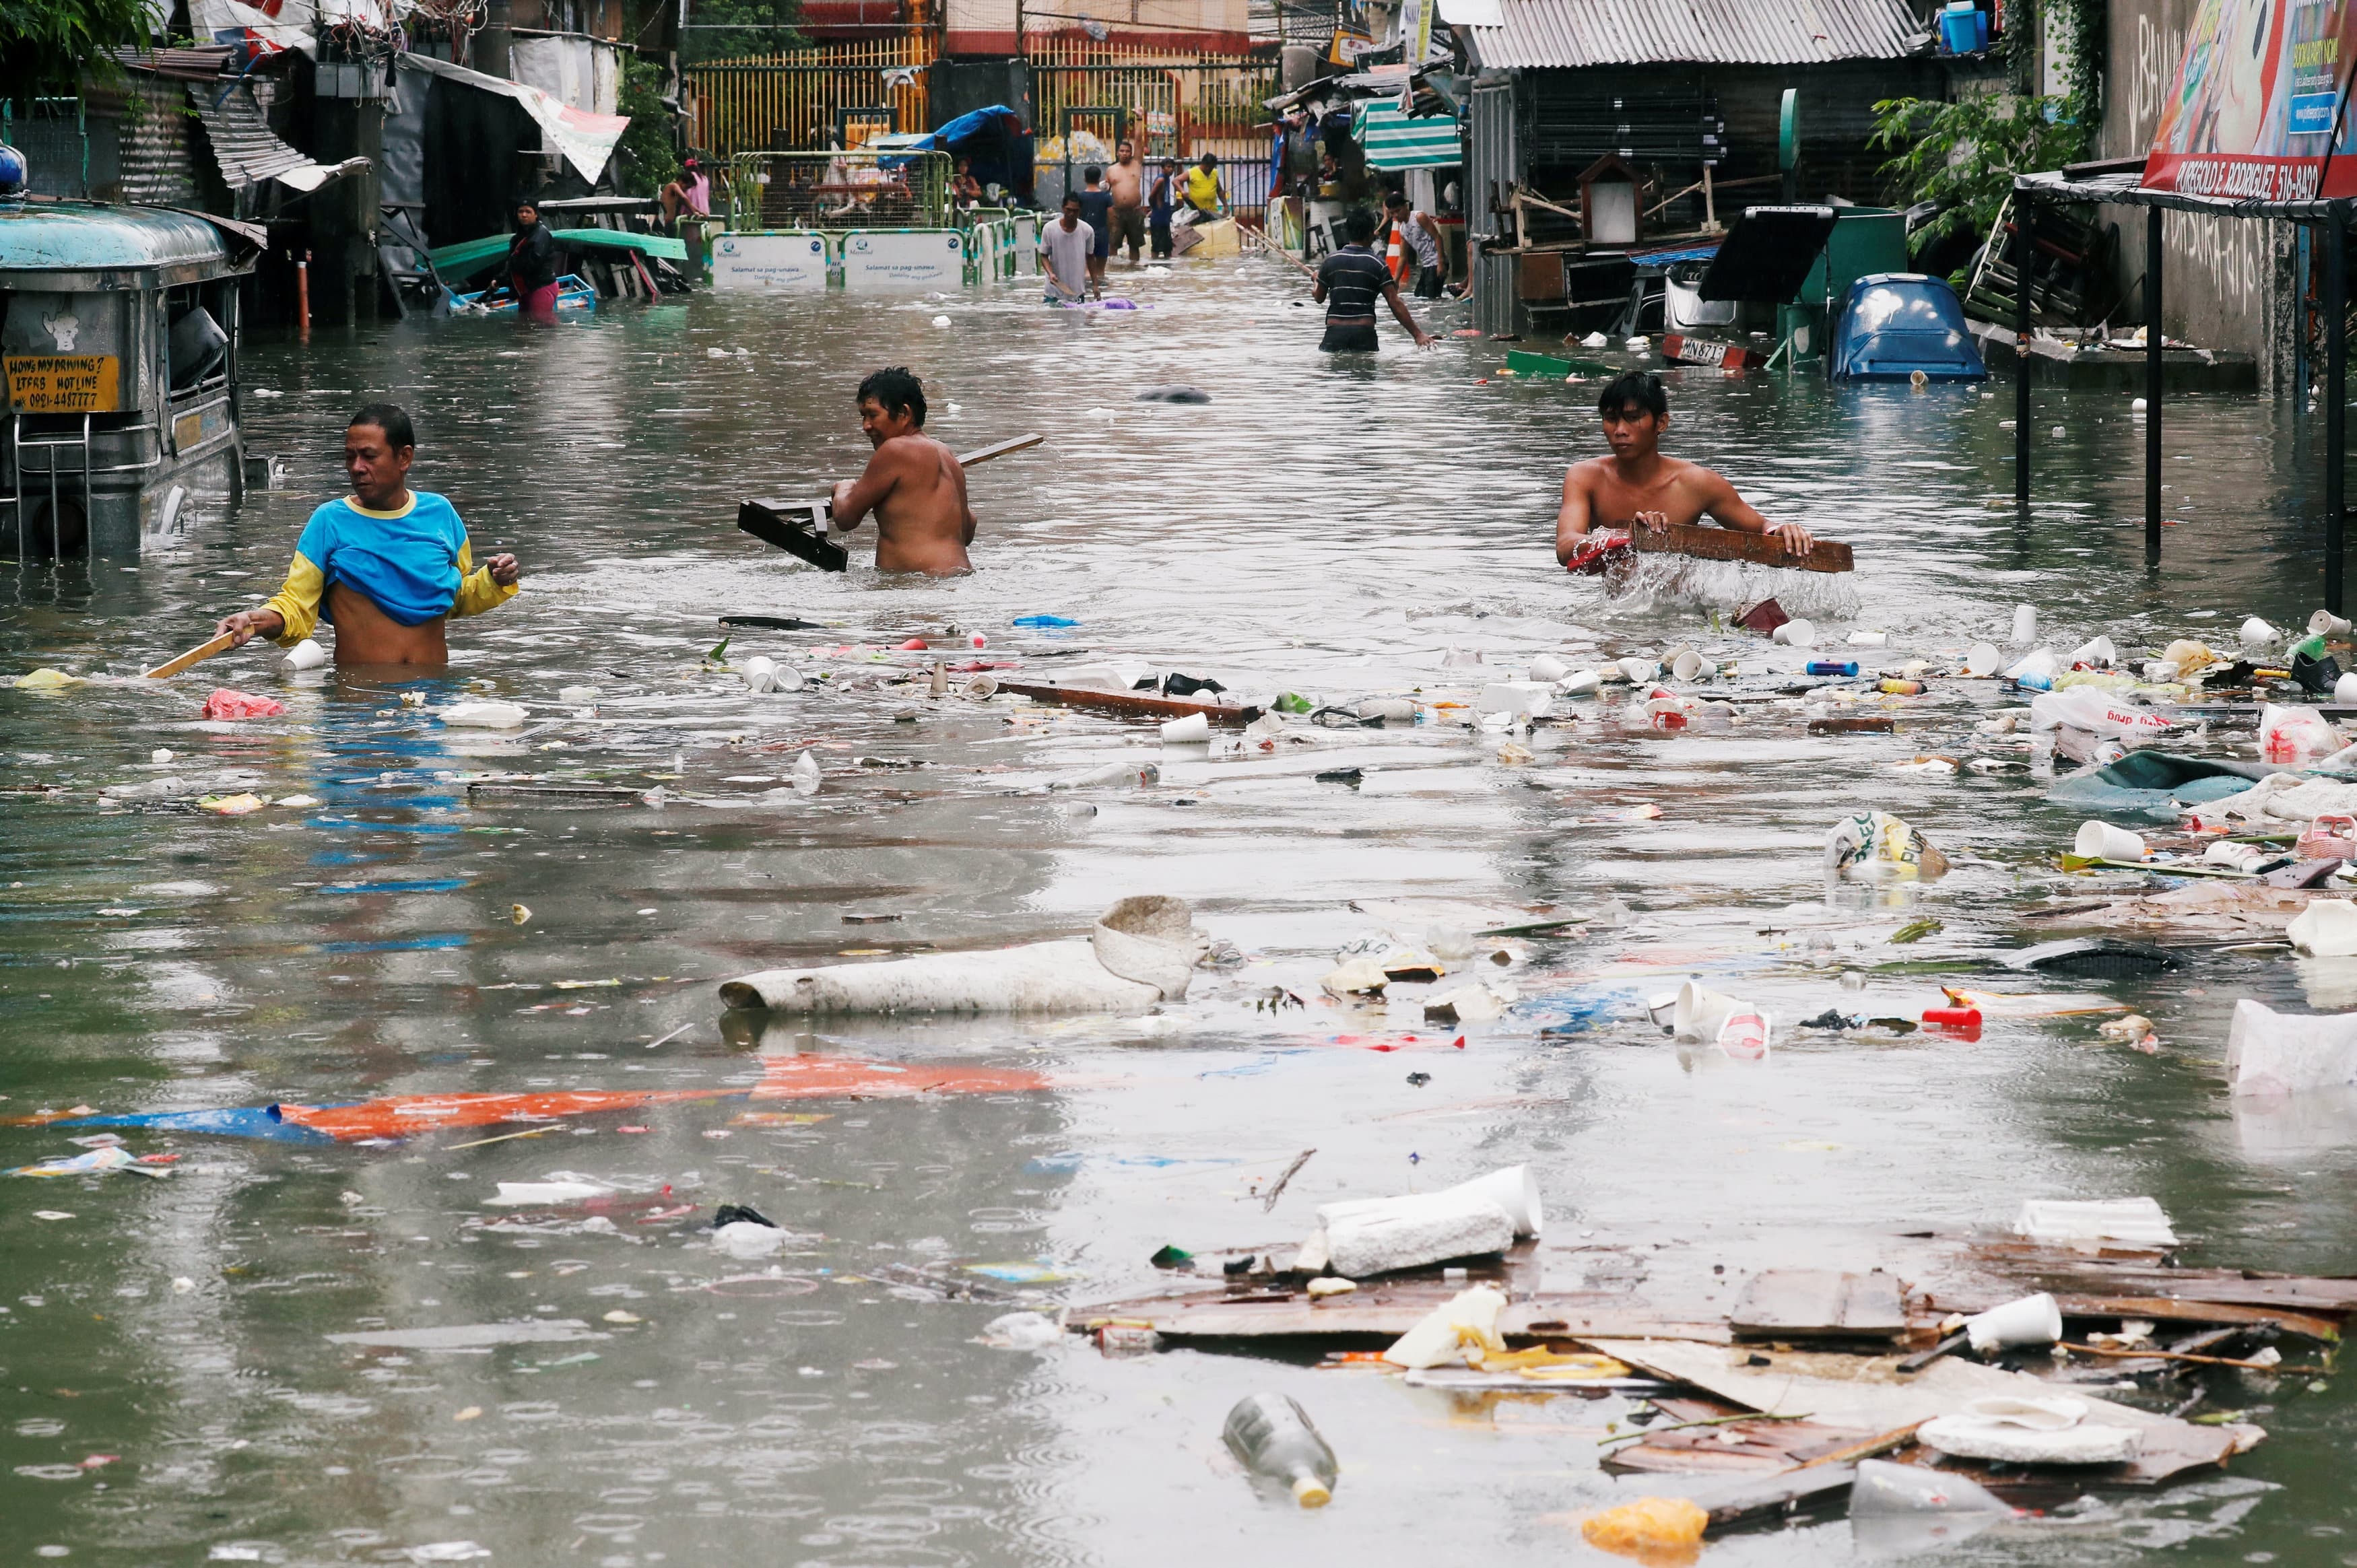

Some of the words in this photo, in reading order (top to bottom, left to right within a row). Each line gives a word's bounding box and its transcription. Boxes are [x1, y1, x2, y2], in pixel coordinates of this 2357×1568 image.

[2175, 160, 2218, 194] PUREGOLD
[2223, 162, 2276, 199] RODRIGUEZ
[2277, 164, 2319, 200] 516-8422
[38, 358, 54, 373] MY
[16, 376, 46, 392] LTFRB
[57, 375, 98, 390] HOTLINE
[2106, 710, 2133, 726] drug
